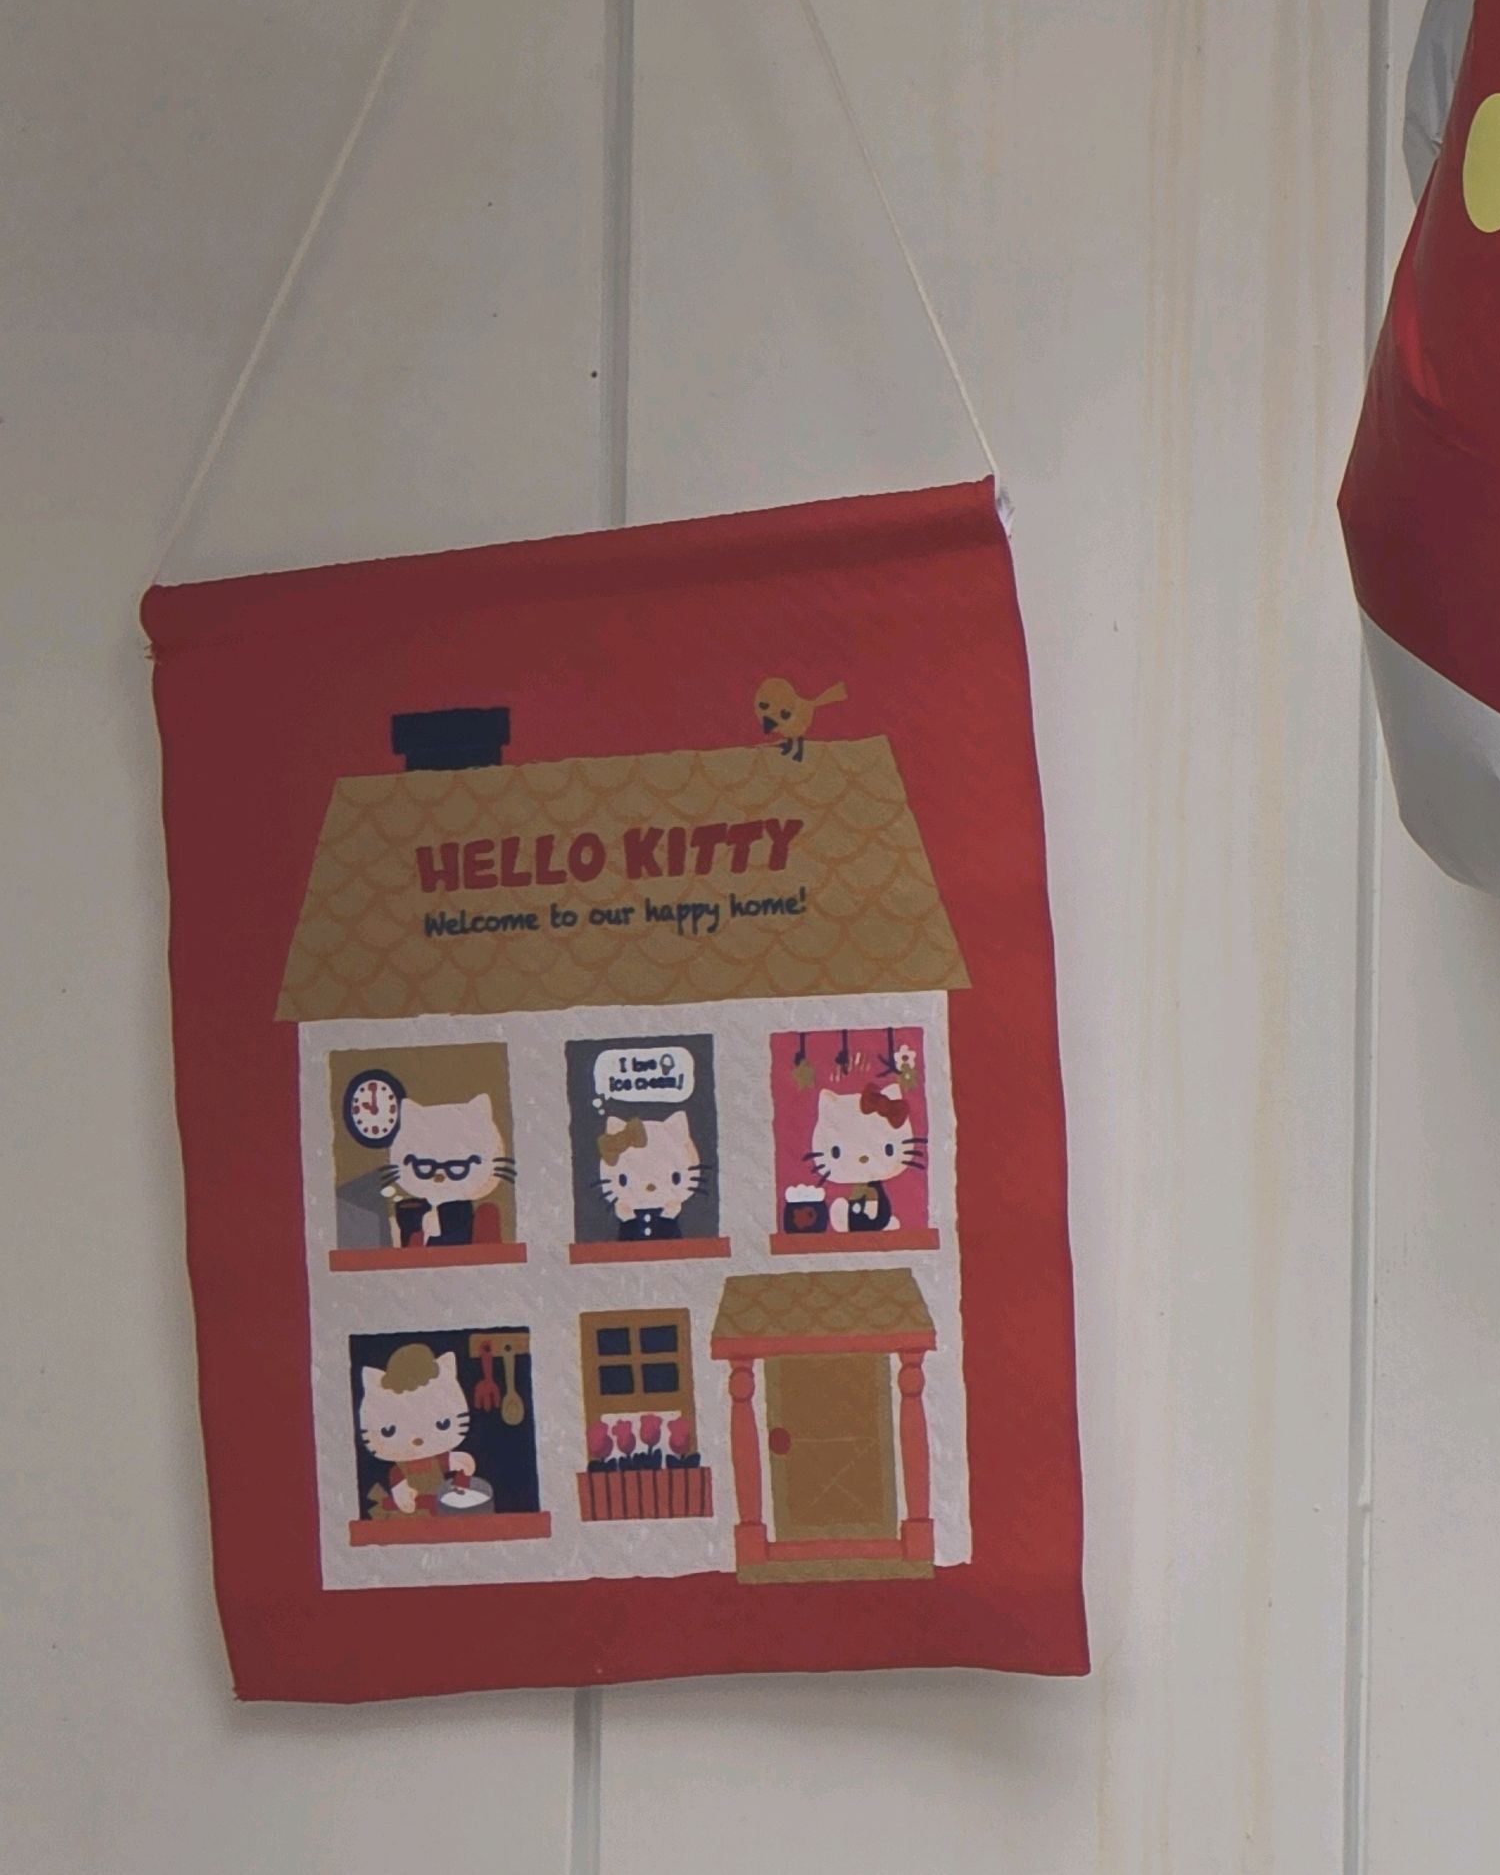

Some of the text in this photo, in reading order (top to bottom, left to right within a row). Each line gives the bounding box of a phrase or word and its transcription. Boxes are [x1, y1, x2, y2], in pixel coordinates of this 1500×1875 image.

[415, 818, 804, 893] HELLO KITTY
[424, 886, 807, 938] Welcome to our happy home!
[619, 1057, 627, 1073] I
